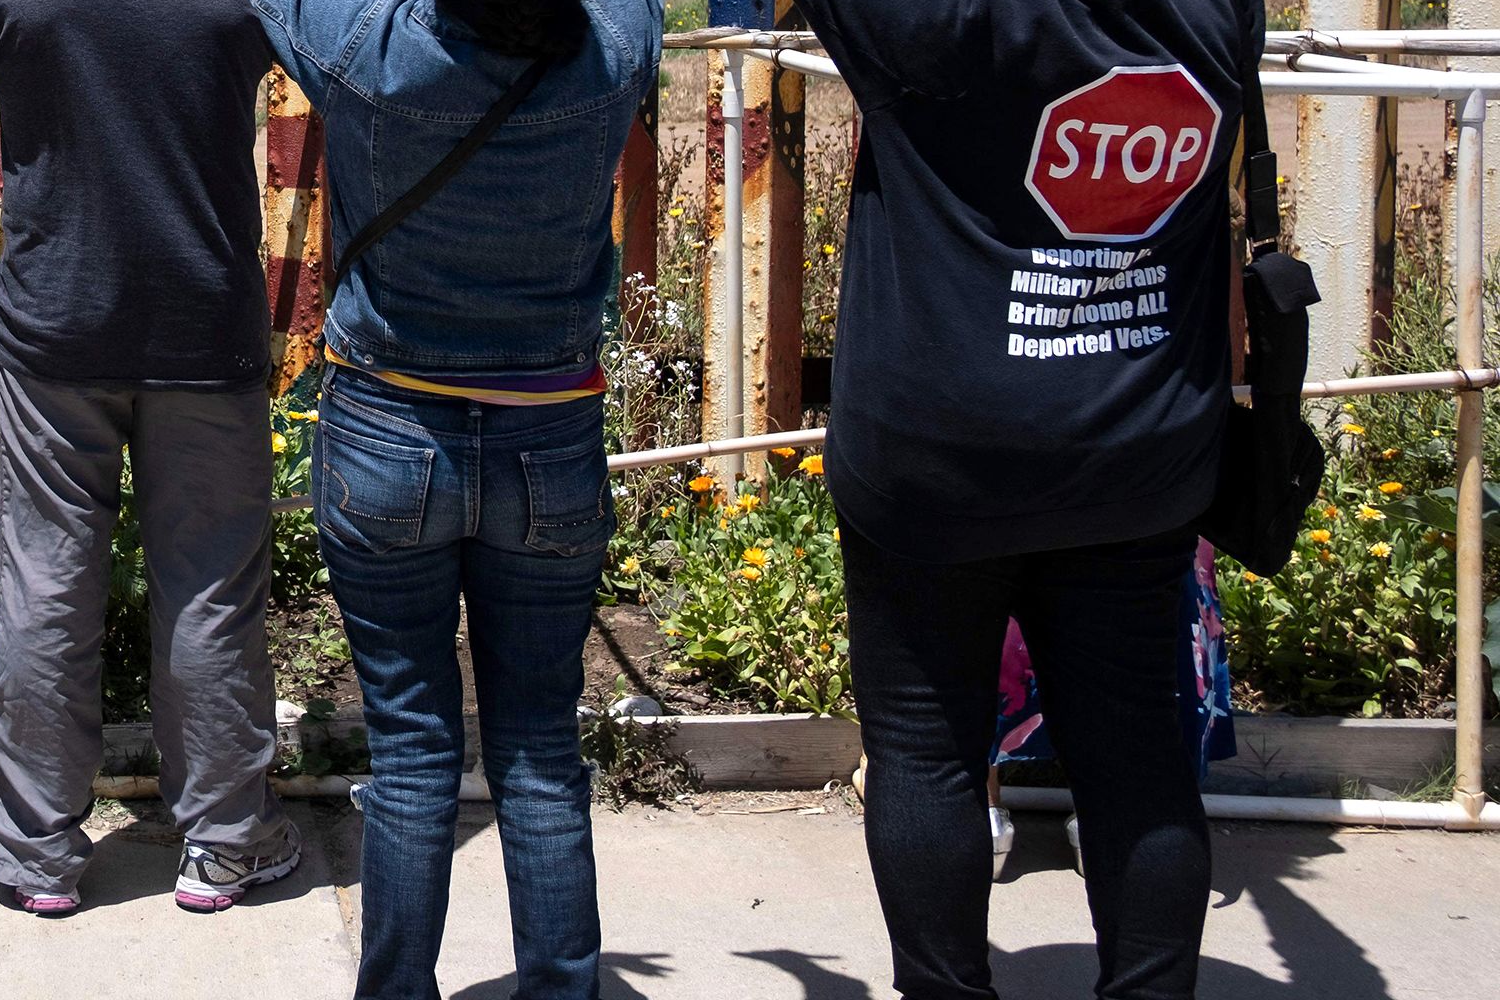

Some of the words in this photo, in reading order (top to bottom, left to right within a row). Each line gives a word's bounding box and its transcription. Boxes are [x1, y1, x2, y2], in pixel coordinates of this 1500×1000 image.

[1048, 119, 1202, 184] STOP
[1031, 247, 1136, 270] Deporting
[1010, 270, 1092, 298] Military
[1008, 301, 1072, 329] Bring
[1072, 299, 1133, 325] home
[1136, 291, 1168, 317] ALL
[1008, 330, 1111, 359] Deported
[1115, 325, 1171, 350] Vets.
